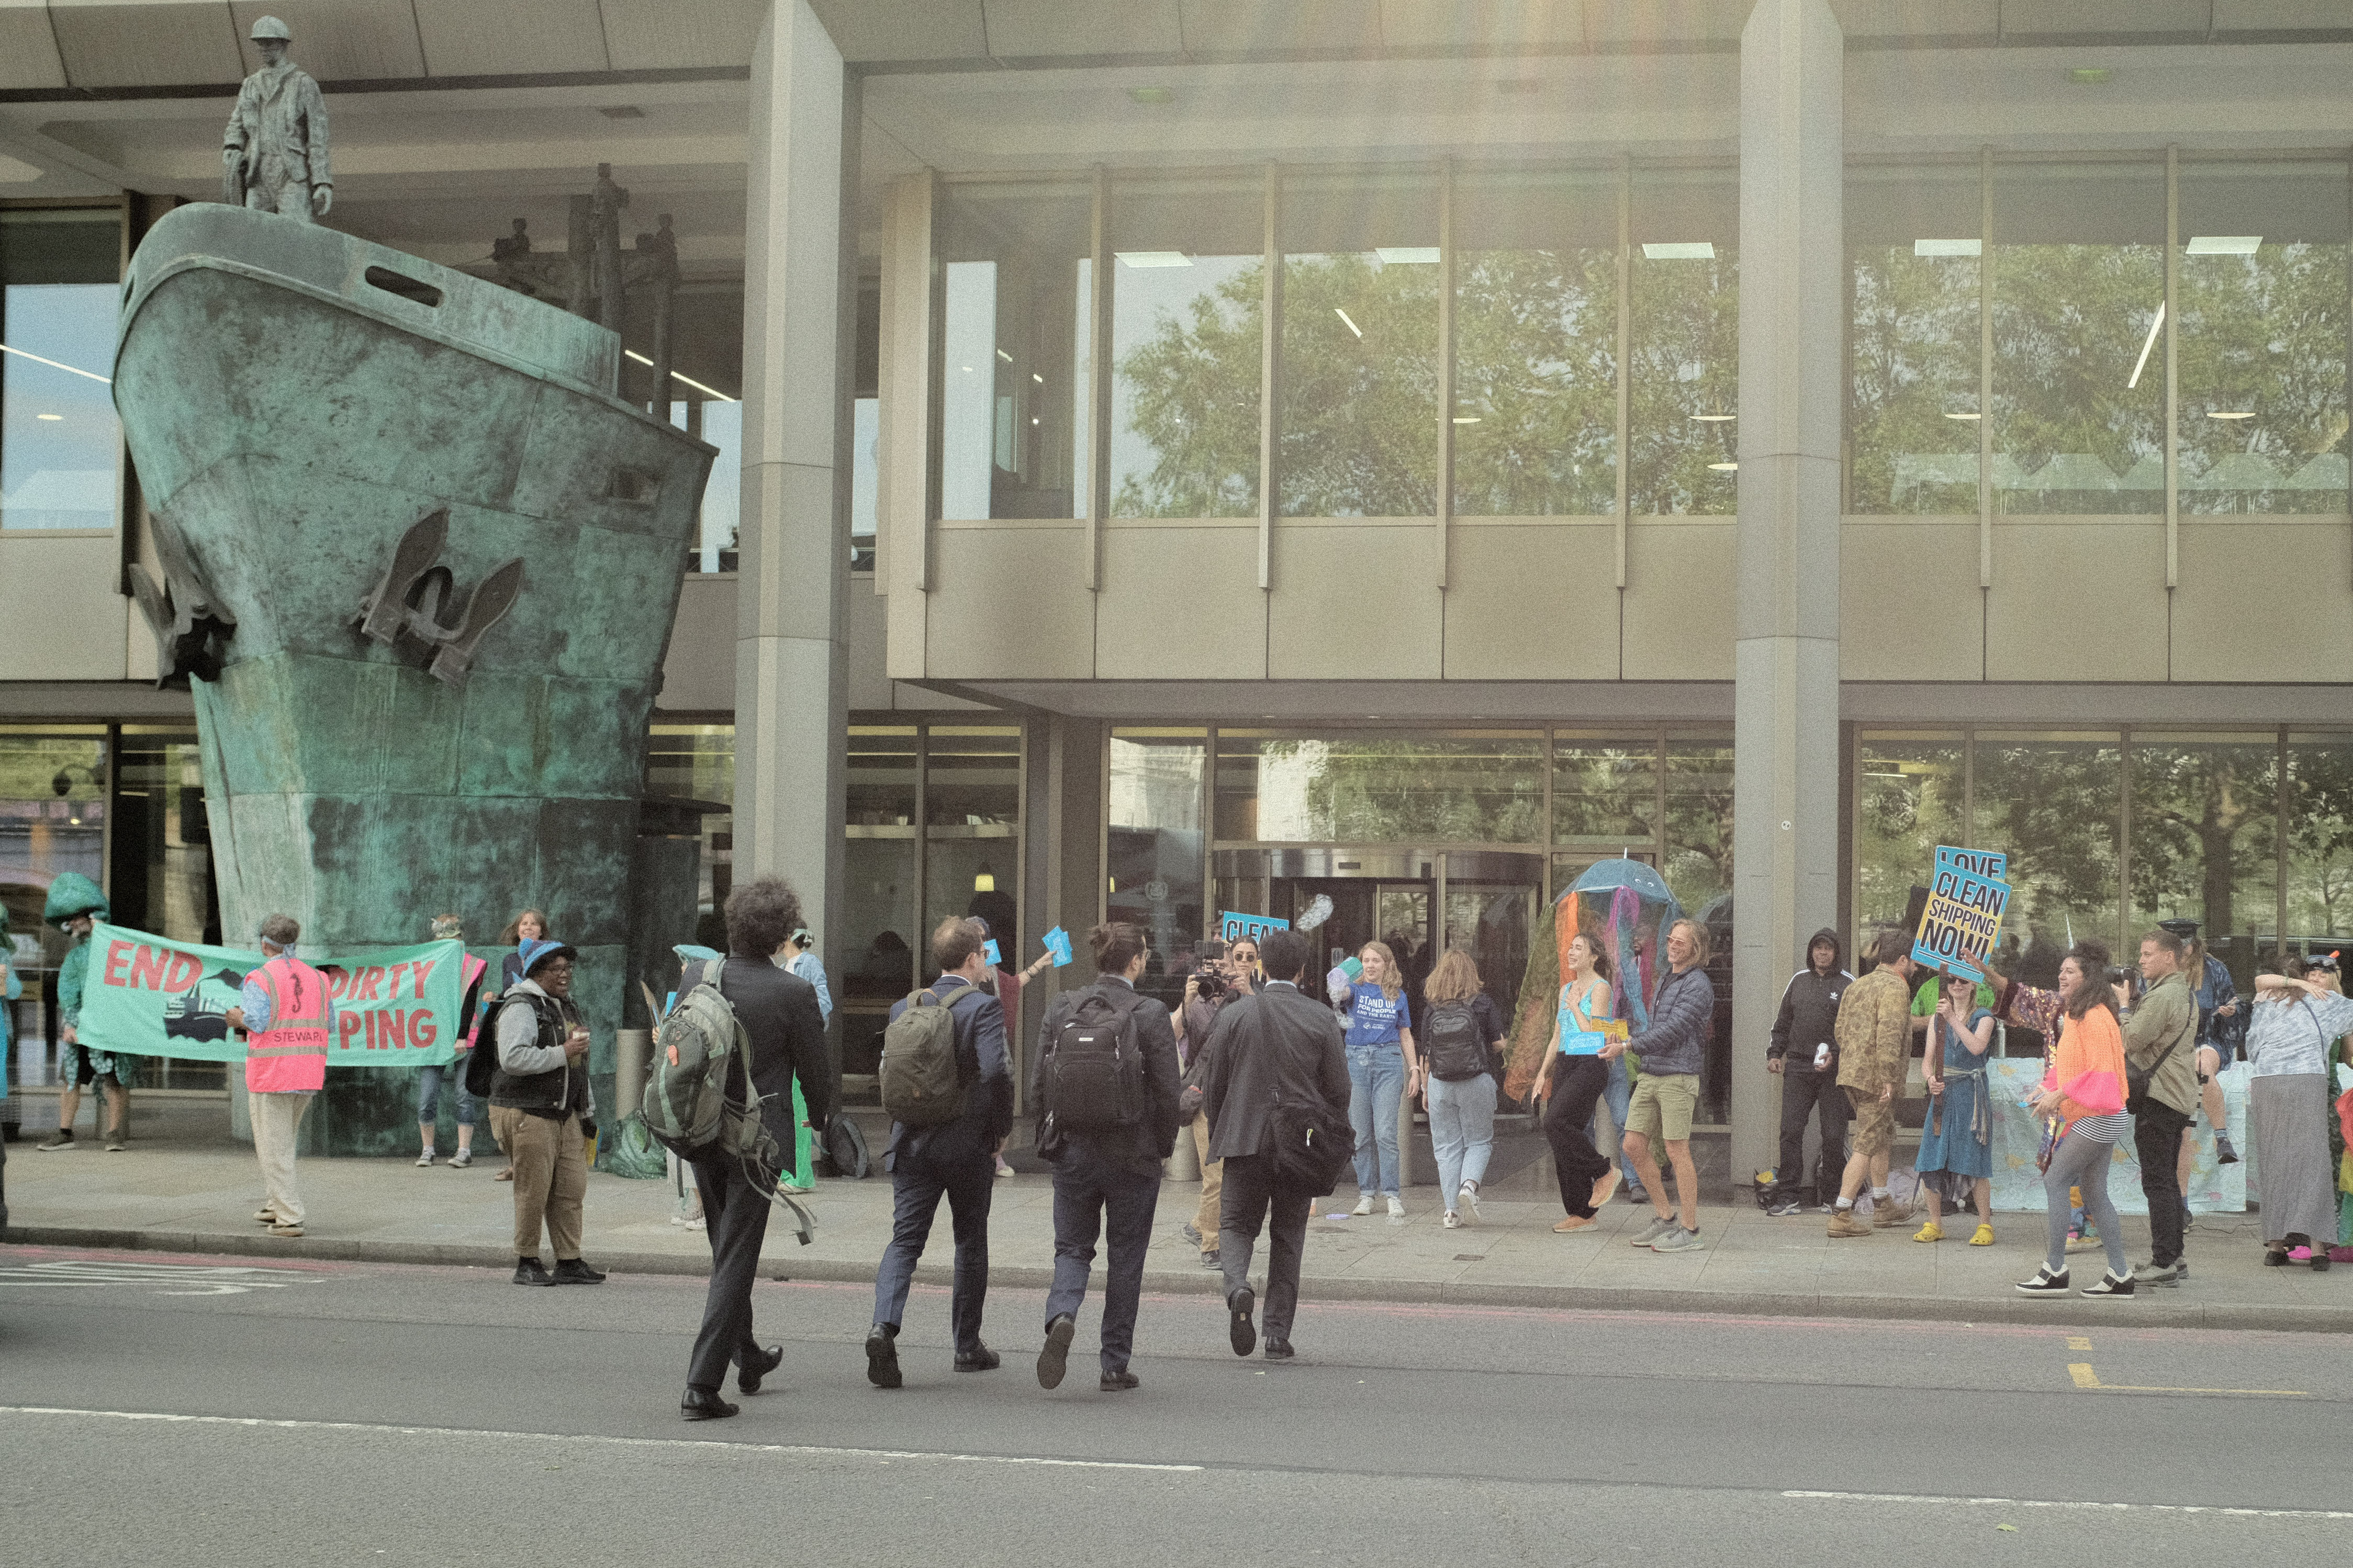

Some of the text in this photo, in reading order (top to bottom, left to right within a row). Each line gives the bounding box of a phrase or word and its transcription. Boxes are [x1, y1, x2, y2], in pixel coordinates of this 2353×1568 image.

[1936, 871, 2005, 917] CLEAN
[1226, 920, 1286, 944] CLEA
[1929, 899, 1996, 937] SHIPPING
[104, 940, 204, 993] END
[328, 961, 436, 1000] DIRTY
[1359, 995, 1395, 1009] STAND UP
[339, 1009, 438, 1050] PING
